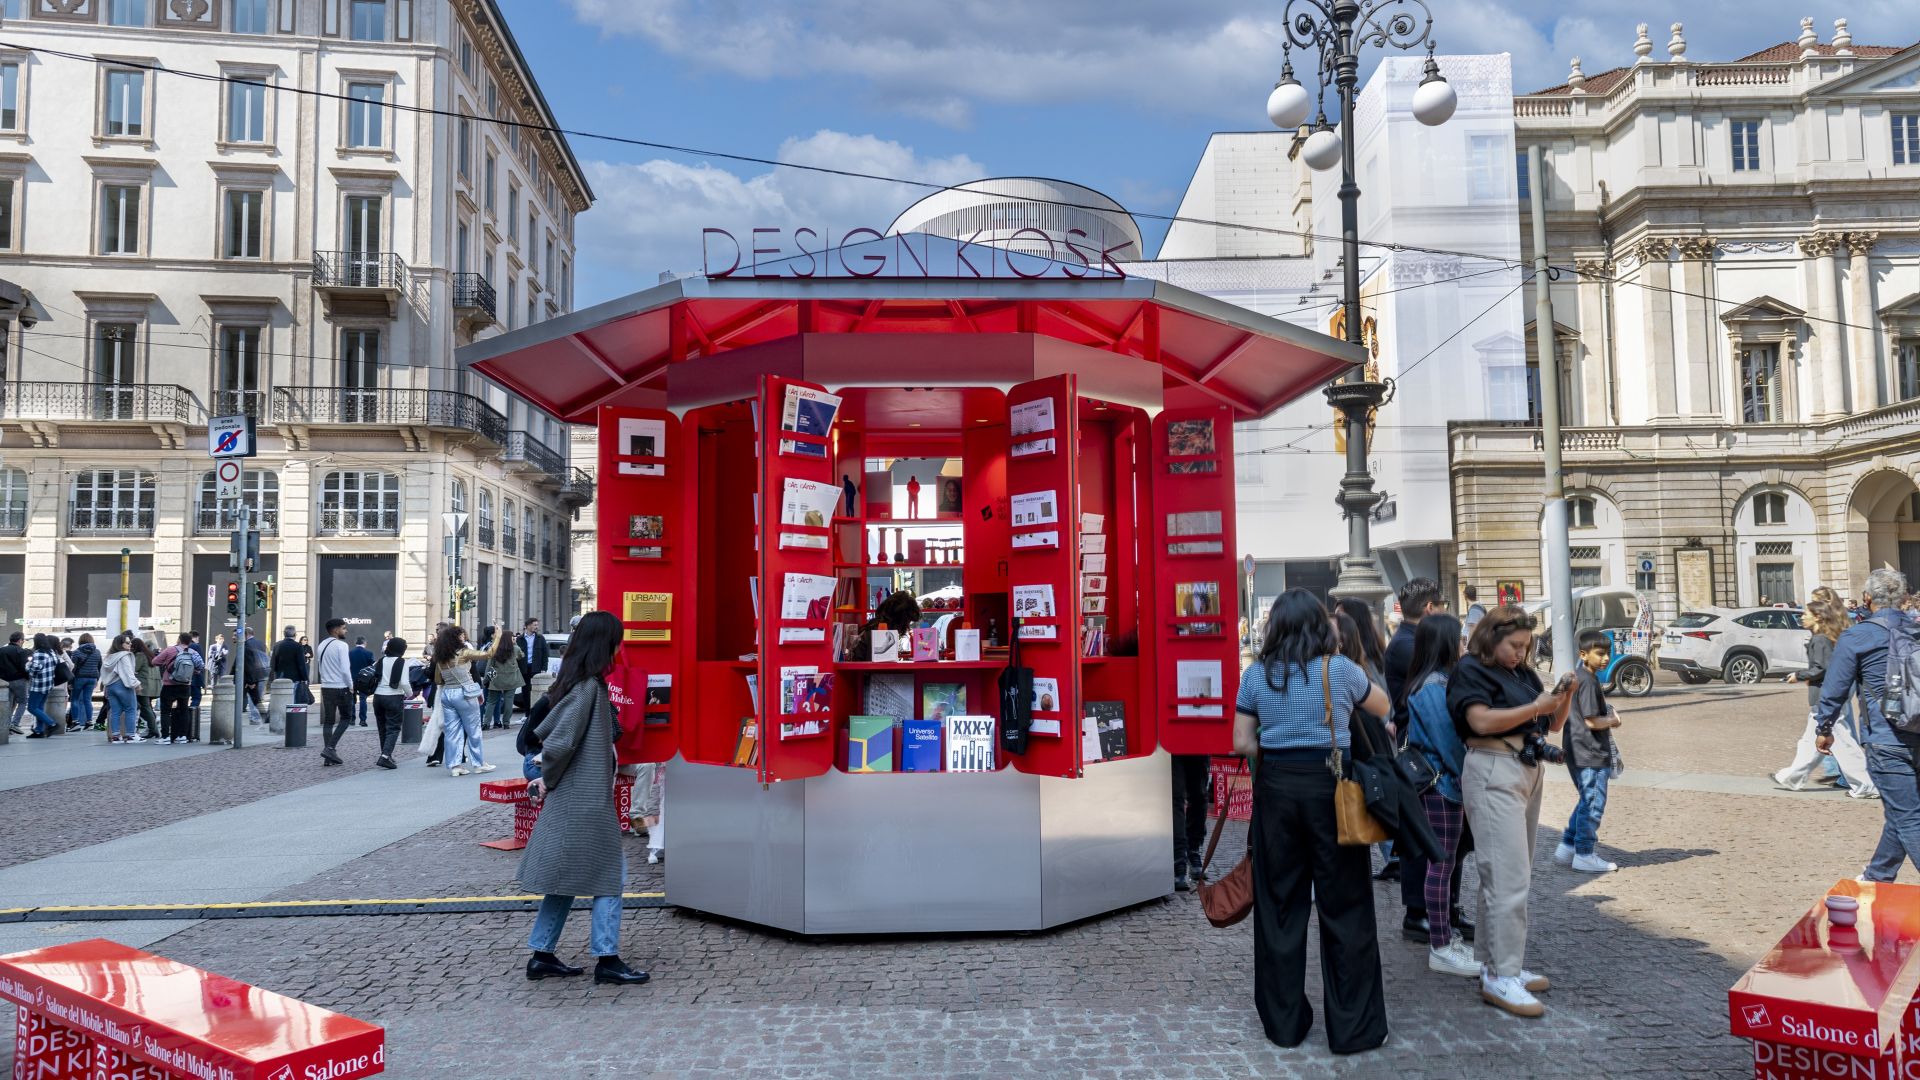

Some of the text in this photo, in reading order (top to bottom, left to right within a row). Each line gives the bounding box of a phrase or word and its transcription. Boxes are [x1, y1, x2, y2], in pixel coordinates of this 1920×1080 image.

[702, 227, 1135, 278] DESIGN KIOSK
[214, 423, 241, 431] pedonale
[631, 593, 668, 602] URBANO
[341, 617, 372, 625] Poliform
[908, 727, 935, 735] Universo
[953, 720, 993, 736] XXX-Y
[621, 786, 629, 819] KIOSK
[46, 994, 68, 1019] Salone
[69, 1004, 80, 1024] del
[144, 1035, 172, 1065] Salone
[172, 1048, 186, 1071] del
[1781, 1014, 1859, 1046] Salone
[304, 1053, 369, 1080] Salone
[1754, 1041, 1876, 1080] DESIGN
